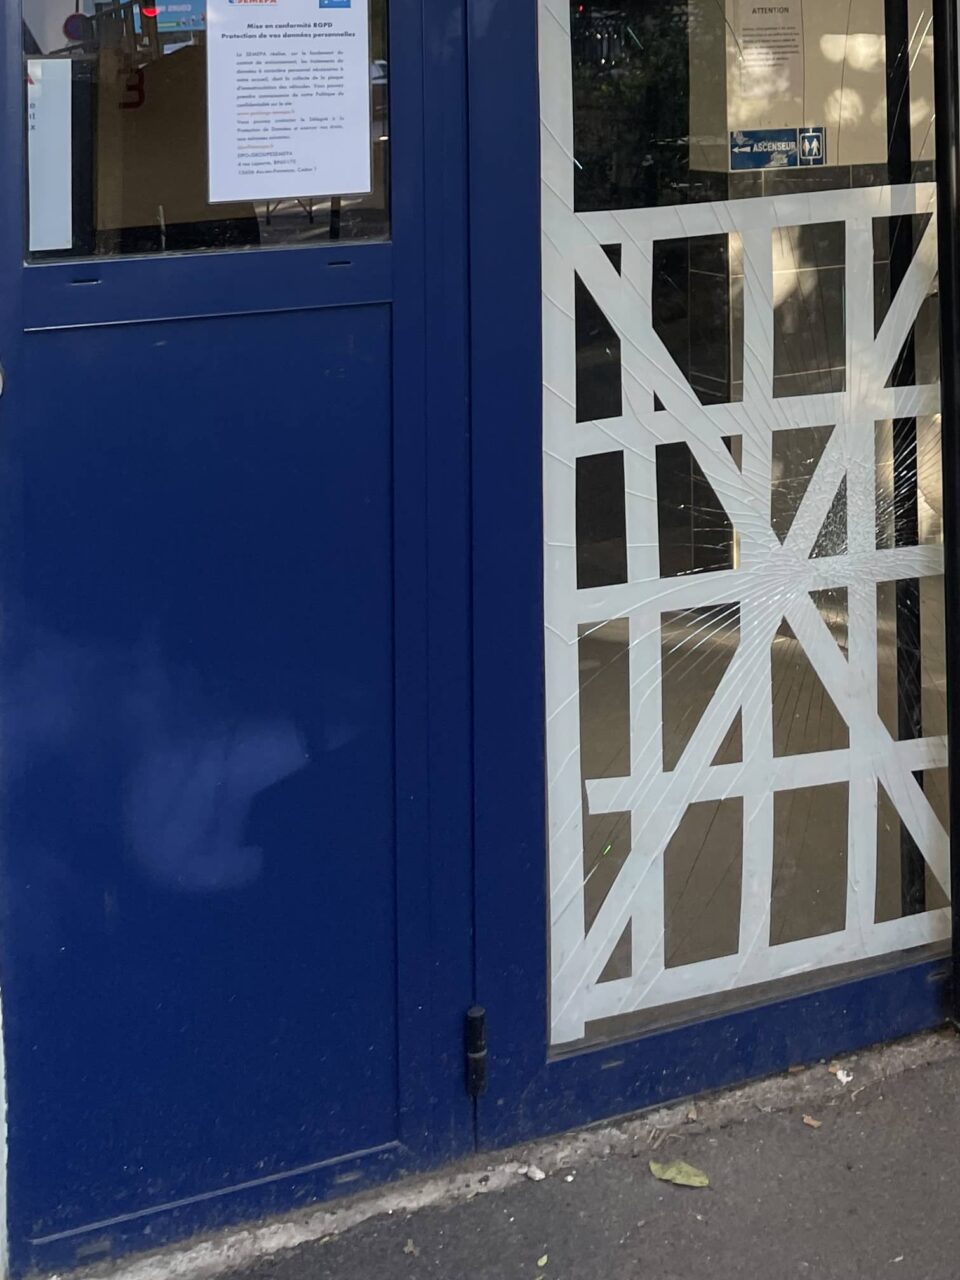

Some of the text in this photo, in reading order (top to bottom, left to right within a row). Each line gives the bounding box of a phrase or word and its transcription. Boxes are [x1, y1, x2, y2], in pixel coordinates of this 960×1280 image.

[752, 7, 789, 15] ATTENTION
[275, 21, 312, 29] conformité
[221, 32, 257, 40] Protection
[282, 31, 311, 39] données
[312, 31, 356, 40] personnelles
[752, 141, 796, 153] ASCENSEUR
